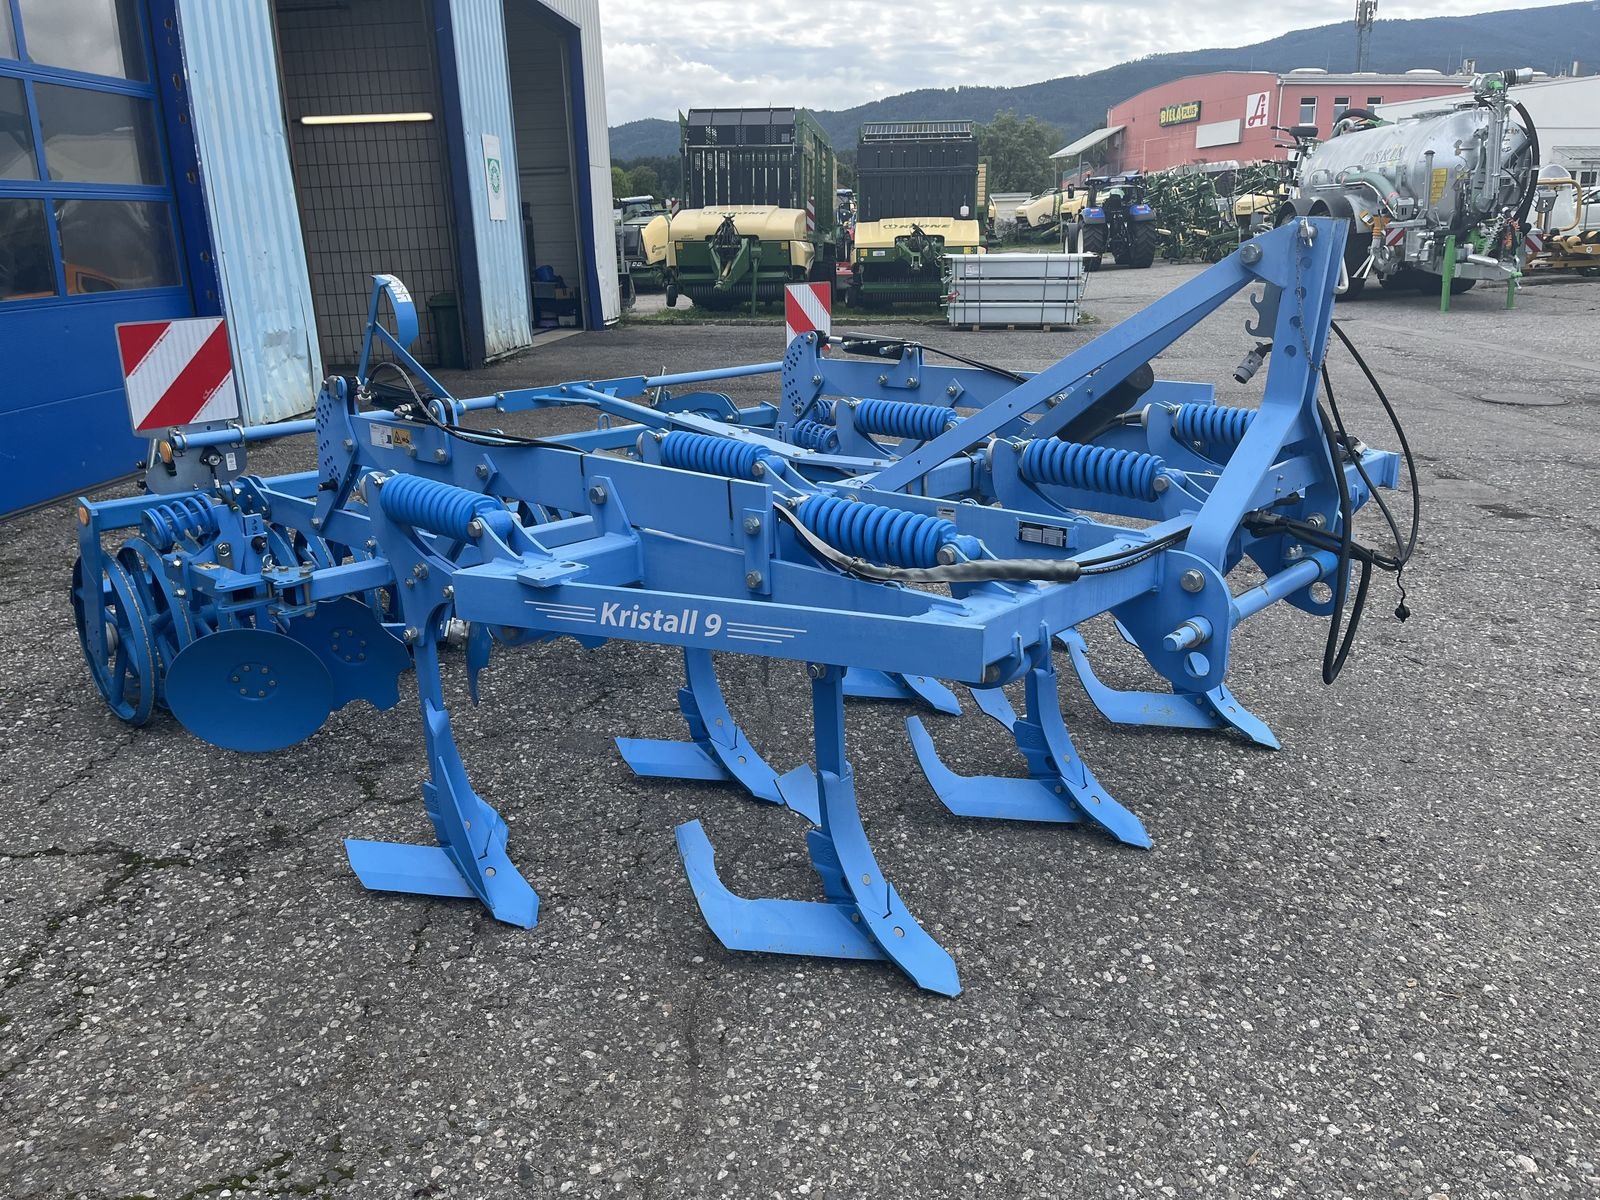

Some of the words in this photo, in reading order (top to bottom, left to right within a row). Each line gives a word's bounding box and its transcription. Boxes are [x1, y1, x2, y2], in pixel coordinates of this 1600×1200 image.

[1160, 106, 1181, 124] BILLA
[1182, 104, 1198, 118] PLUS
[600, 601, 699, 635] Kristall
[703, 613, 723, 637] 9
